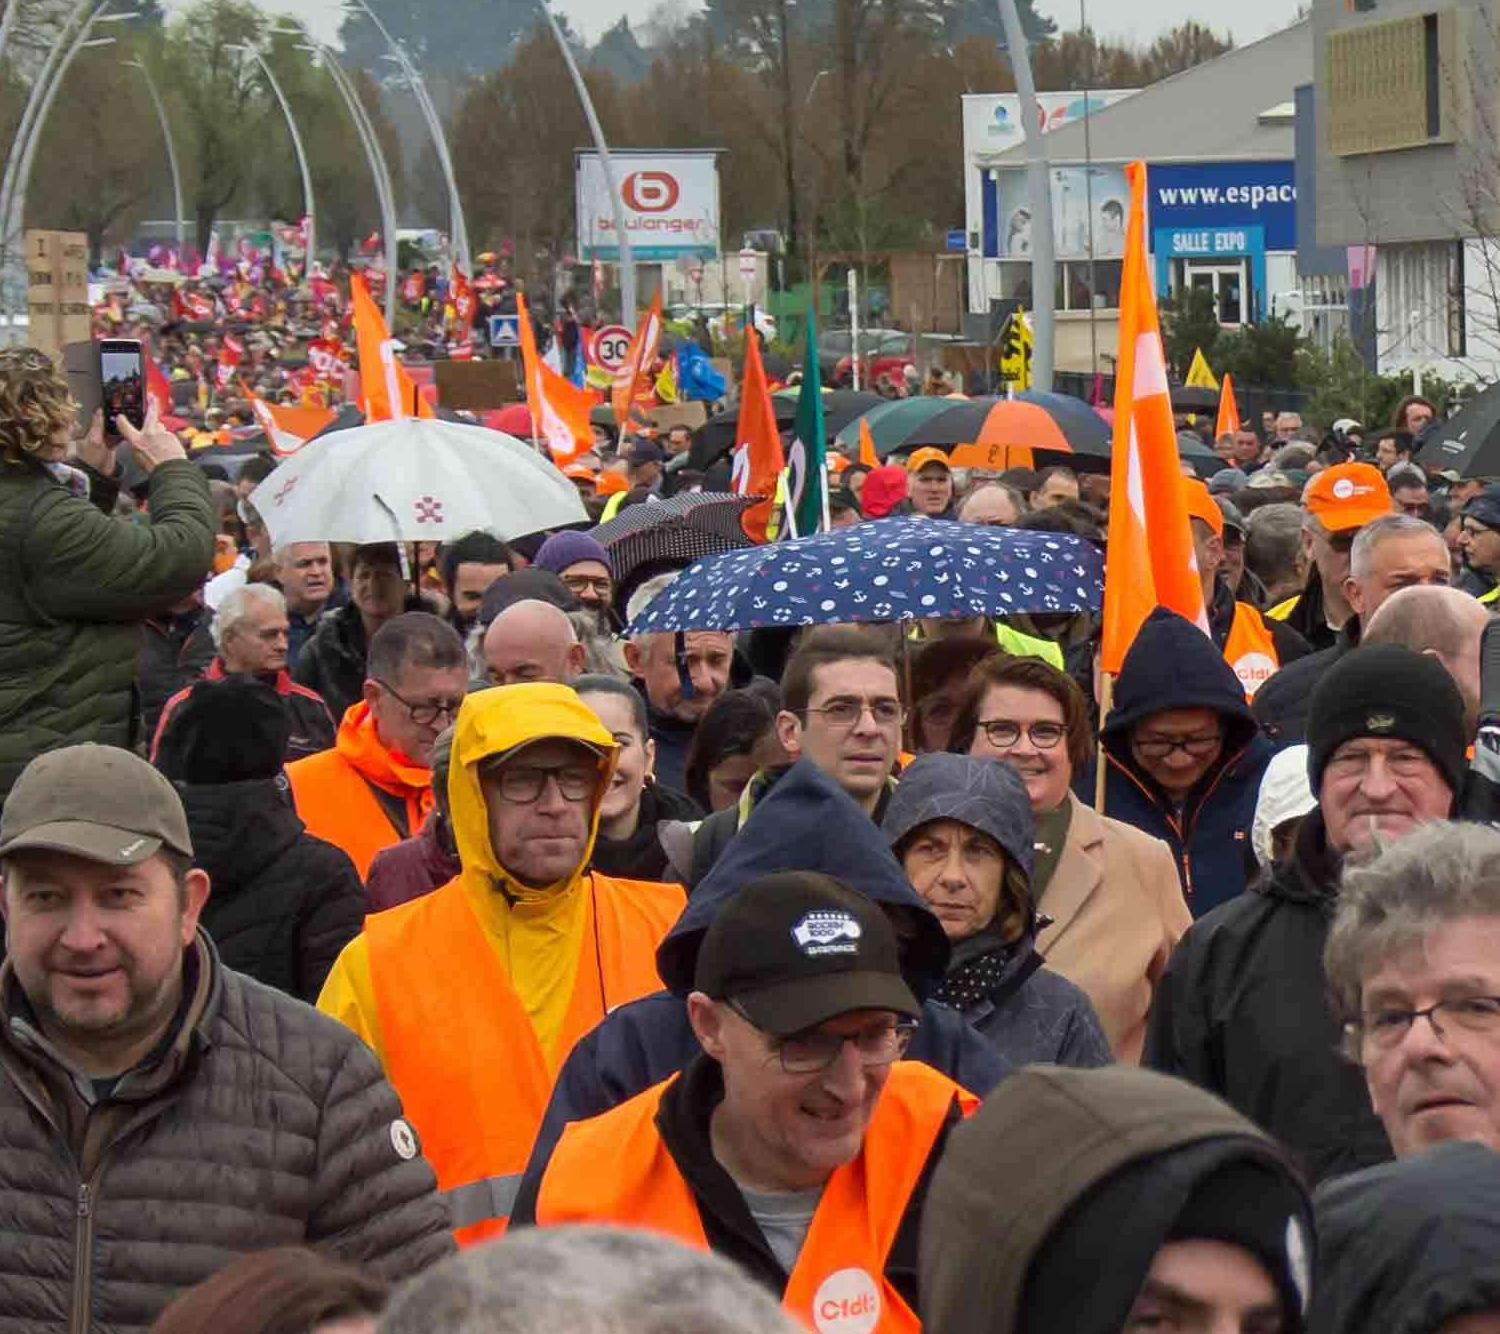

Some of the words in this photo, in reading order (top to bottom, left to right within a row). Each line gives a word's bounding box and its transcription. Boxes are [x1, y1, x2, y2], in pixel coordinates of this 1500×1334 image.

[1172, 232, 1209, 252] SALLE
[1214, 231, 1245, 251] EXPO
[601, 340, 629, 360] 30
